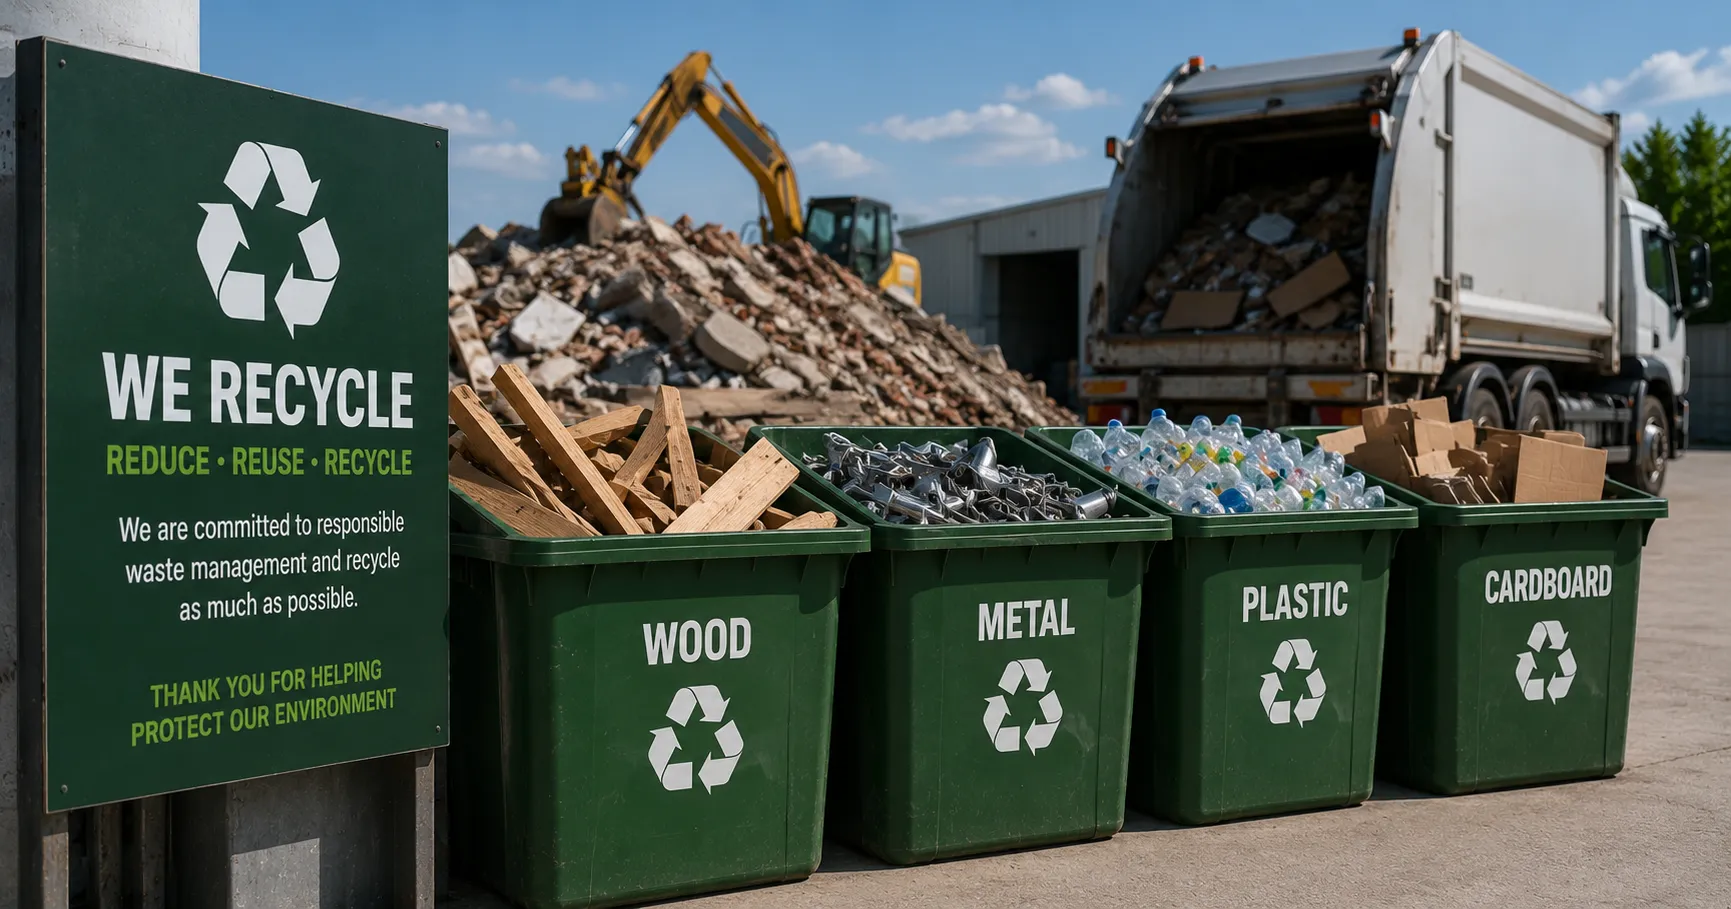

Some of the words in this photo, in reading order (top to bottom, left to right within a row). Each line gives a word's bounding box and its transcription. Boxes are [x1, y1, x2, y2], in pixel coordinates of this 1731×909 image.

[101, 351, 192, 423] WE
[210, 359, 414, 429] RECYCLE
[107, 445, 210, 475] REDUCE
[233, 447, 304, 475] REUSE
[325, 448, 412, 475] RECYCLE
[118, 516, 152, 543] We
[157, 521, 189, 541] are
[194, 512, 290, 540] committed
[294, 514, 312, 536] to
[317, 509, 405, 540] responsible
[125, 556, 185, 584] waste
[191, 552, 308, 583] management
[311, 548, 341, 573] and
[346, 545, 400, 575] recycle
[1484, 564, 1613, 605] CARDBOARD
[179, 601, 201, 622] as
[207, 591, 257, 619] much
[262, 595, 283, 615] as
[287, 585, 359, 619] possible.
[978, 597, 1076, 642] METAL
[1242, 580, 1349, 623] PLASTIC
[642, 616, 752, 666] WOOD
[150, 677, 221, 708] THANK
[226, 672, 265, 698] YOU
[271, 668, 305, 693] FOR
[311, 659, 382, 688] HELPING
[132, 710, 224, 746] PROTECT
[230, 705, 269, 732] OUR
[275, 687, 397, 725] ENVIRONMENT
